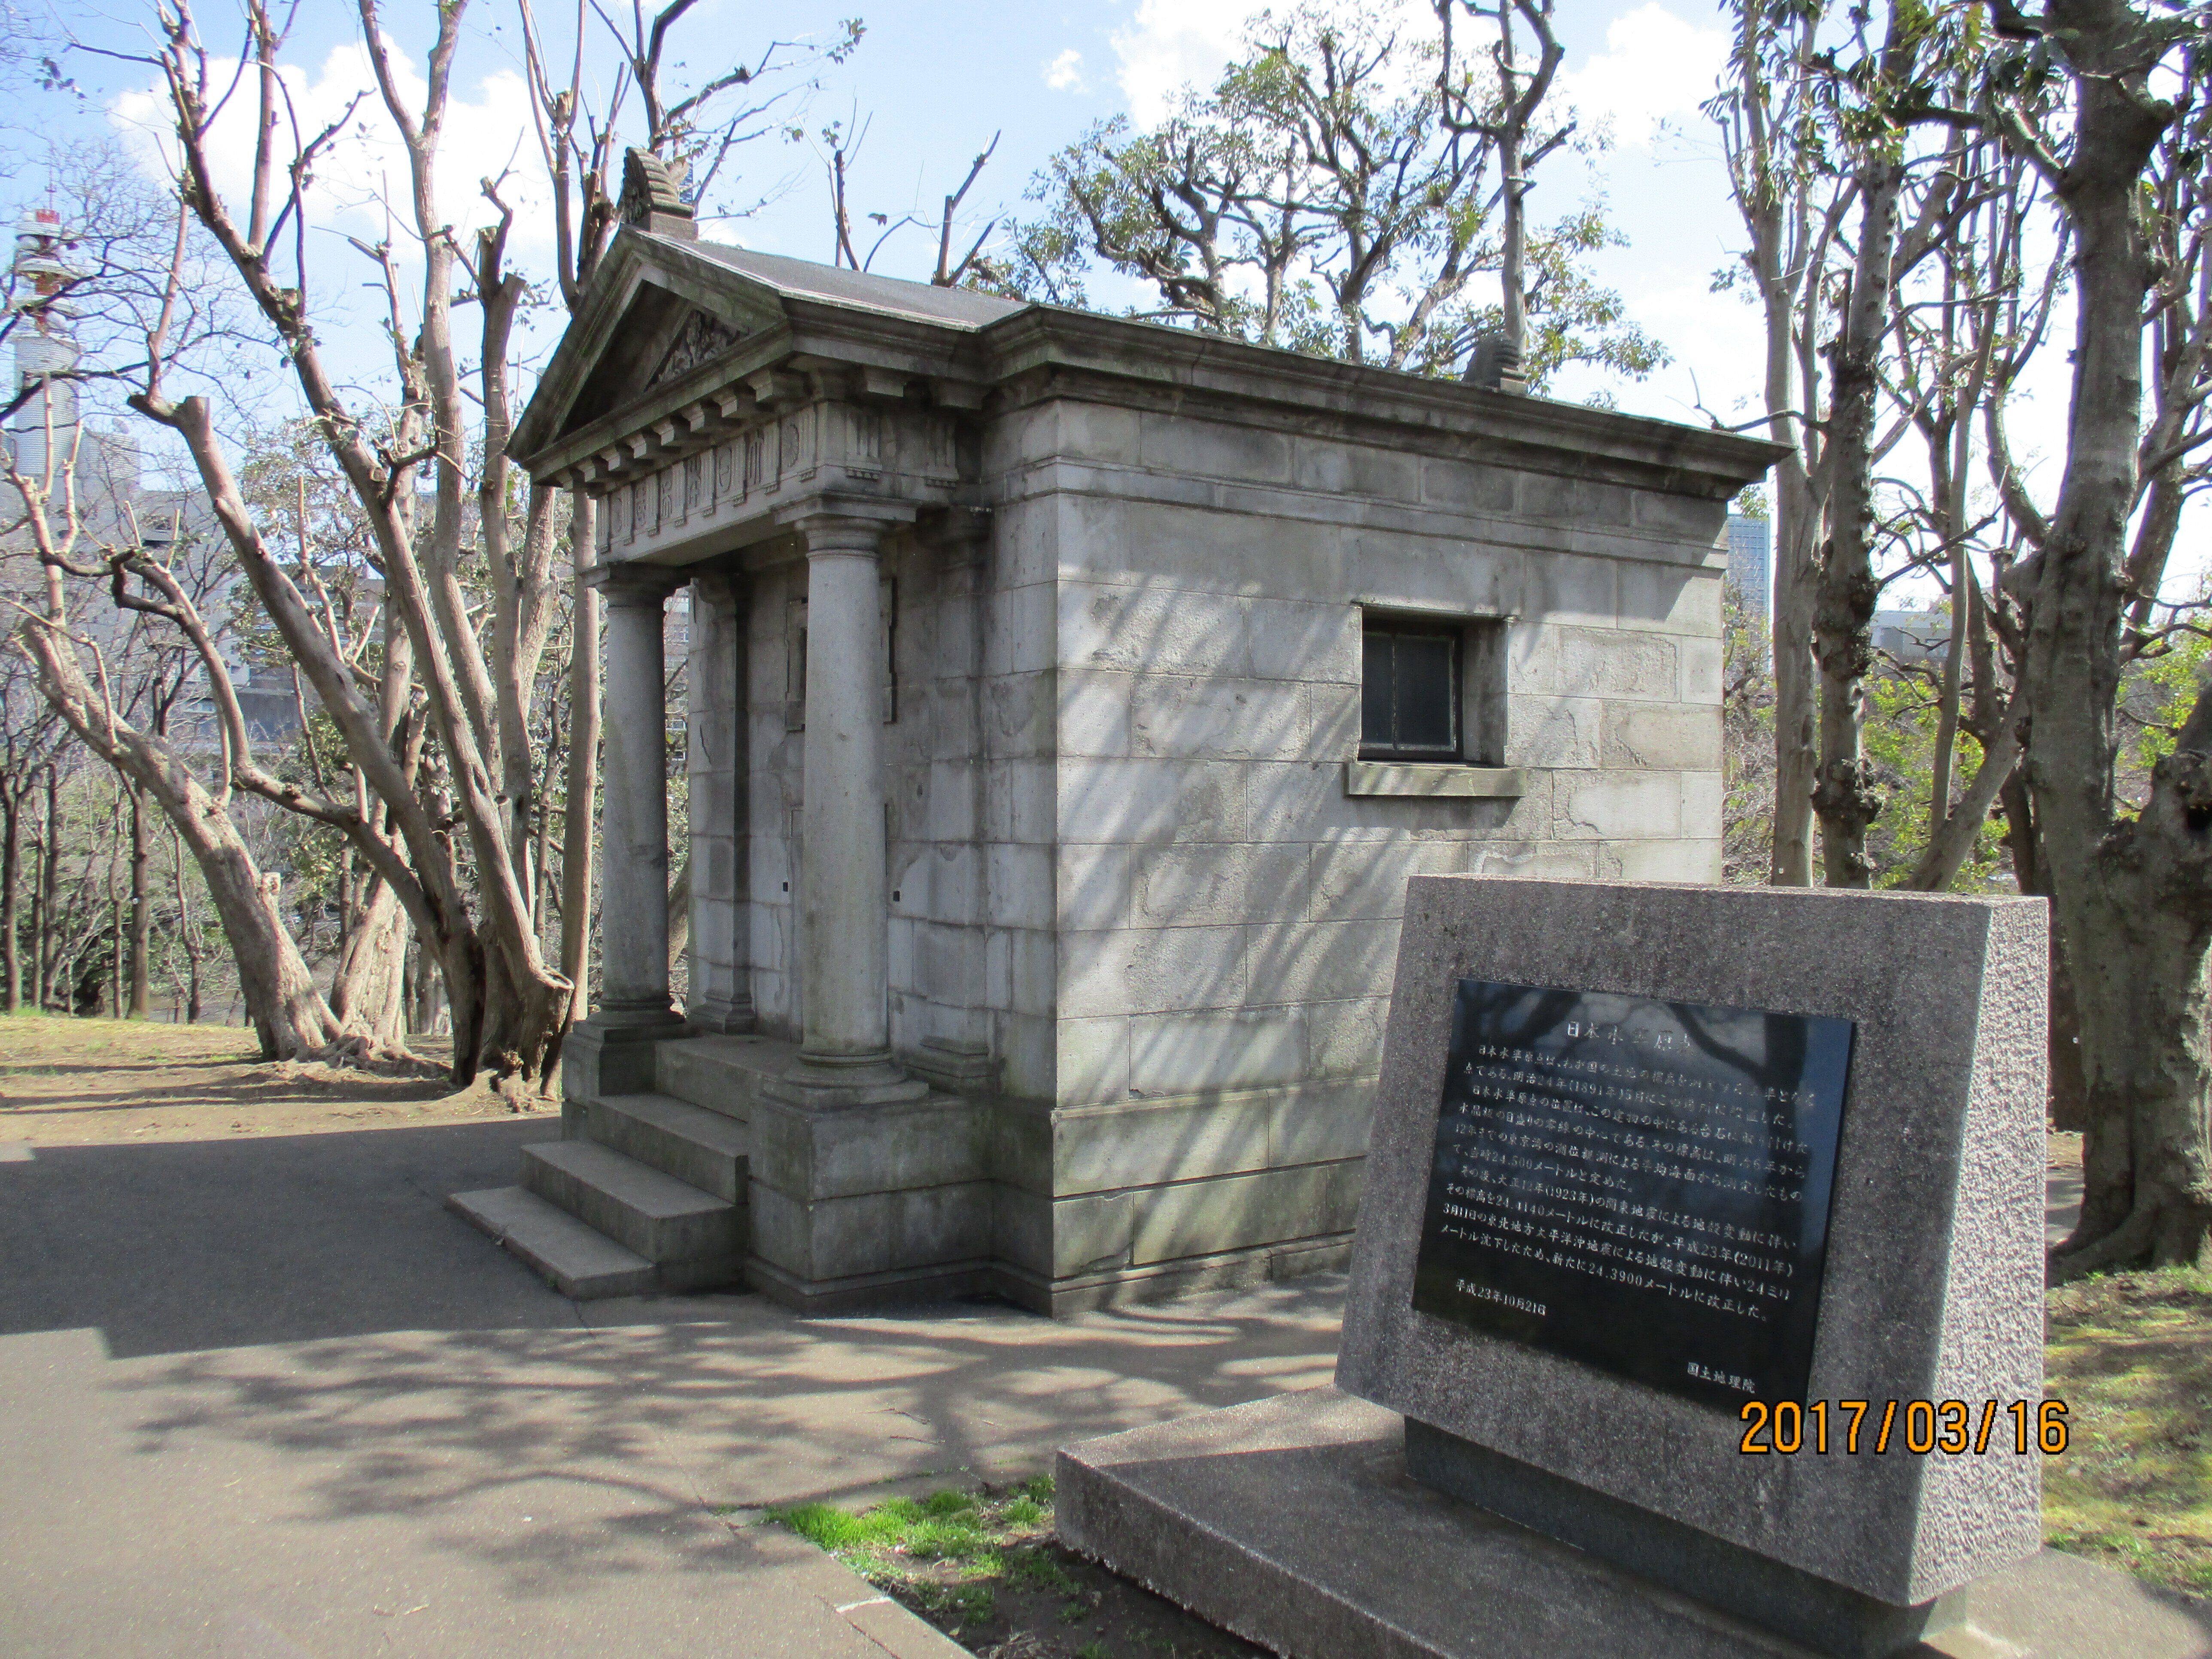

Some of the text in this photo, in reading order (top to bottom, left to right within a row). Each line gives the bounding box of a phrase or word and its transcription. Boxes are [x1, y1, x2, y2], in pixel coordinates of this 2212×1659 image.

[1455, 1278, 1547, 1317] 平成23年10月21日
[1686, 1361, 1756, 1395] 国土地理院
